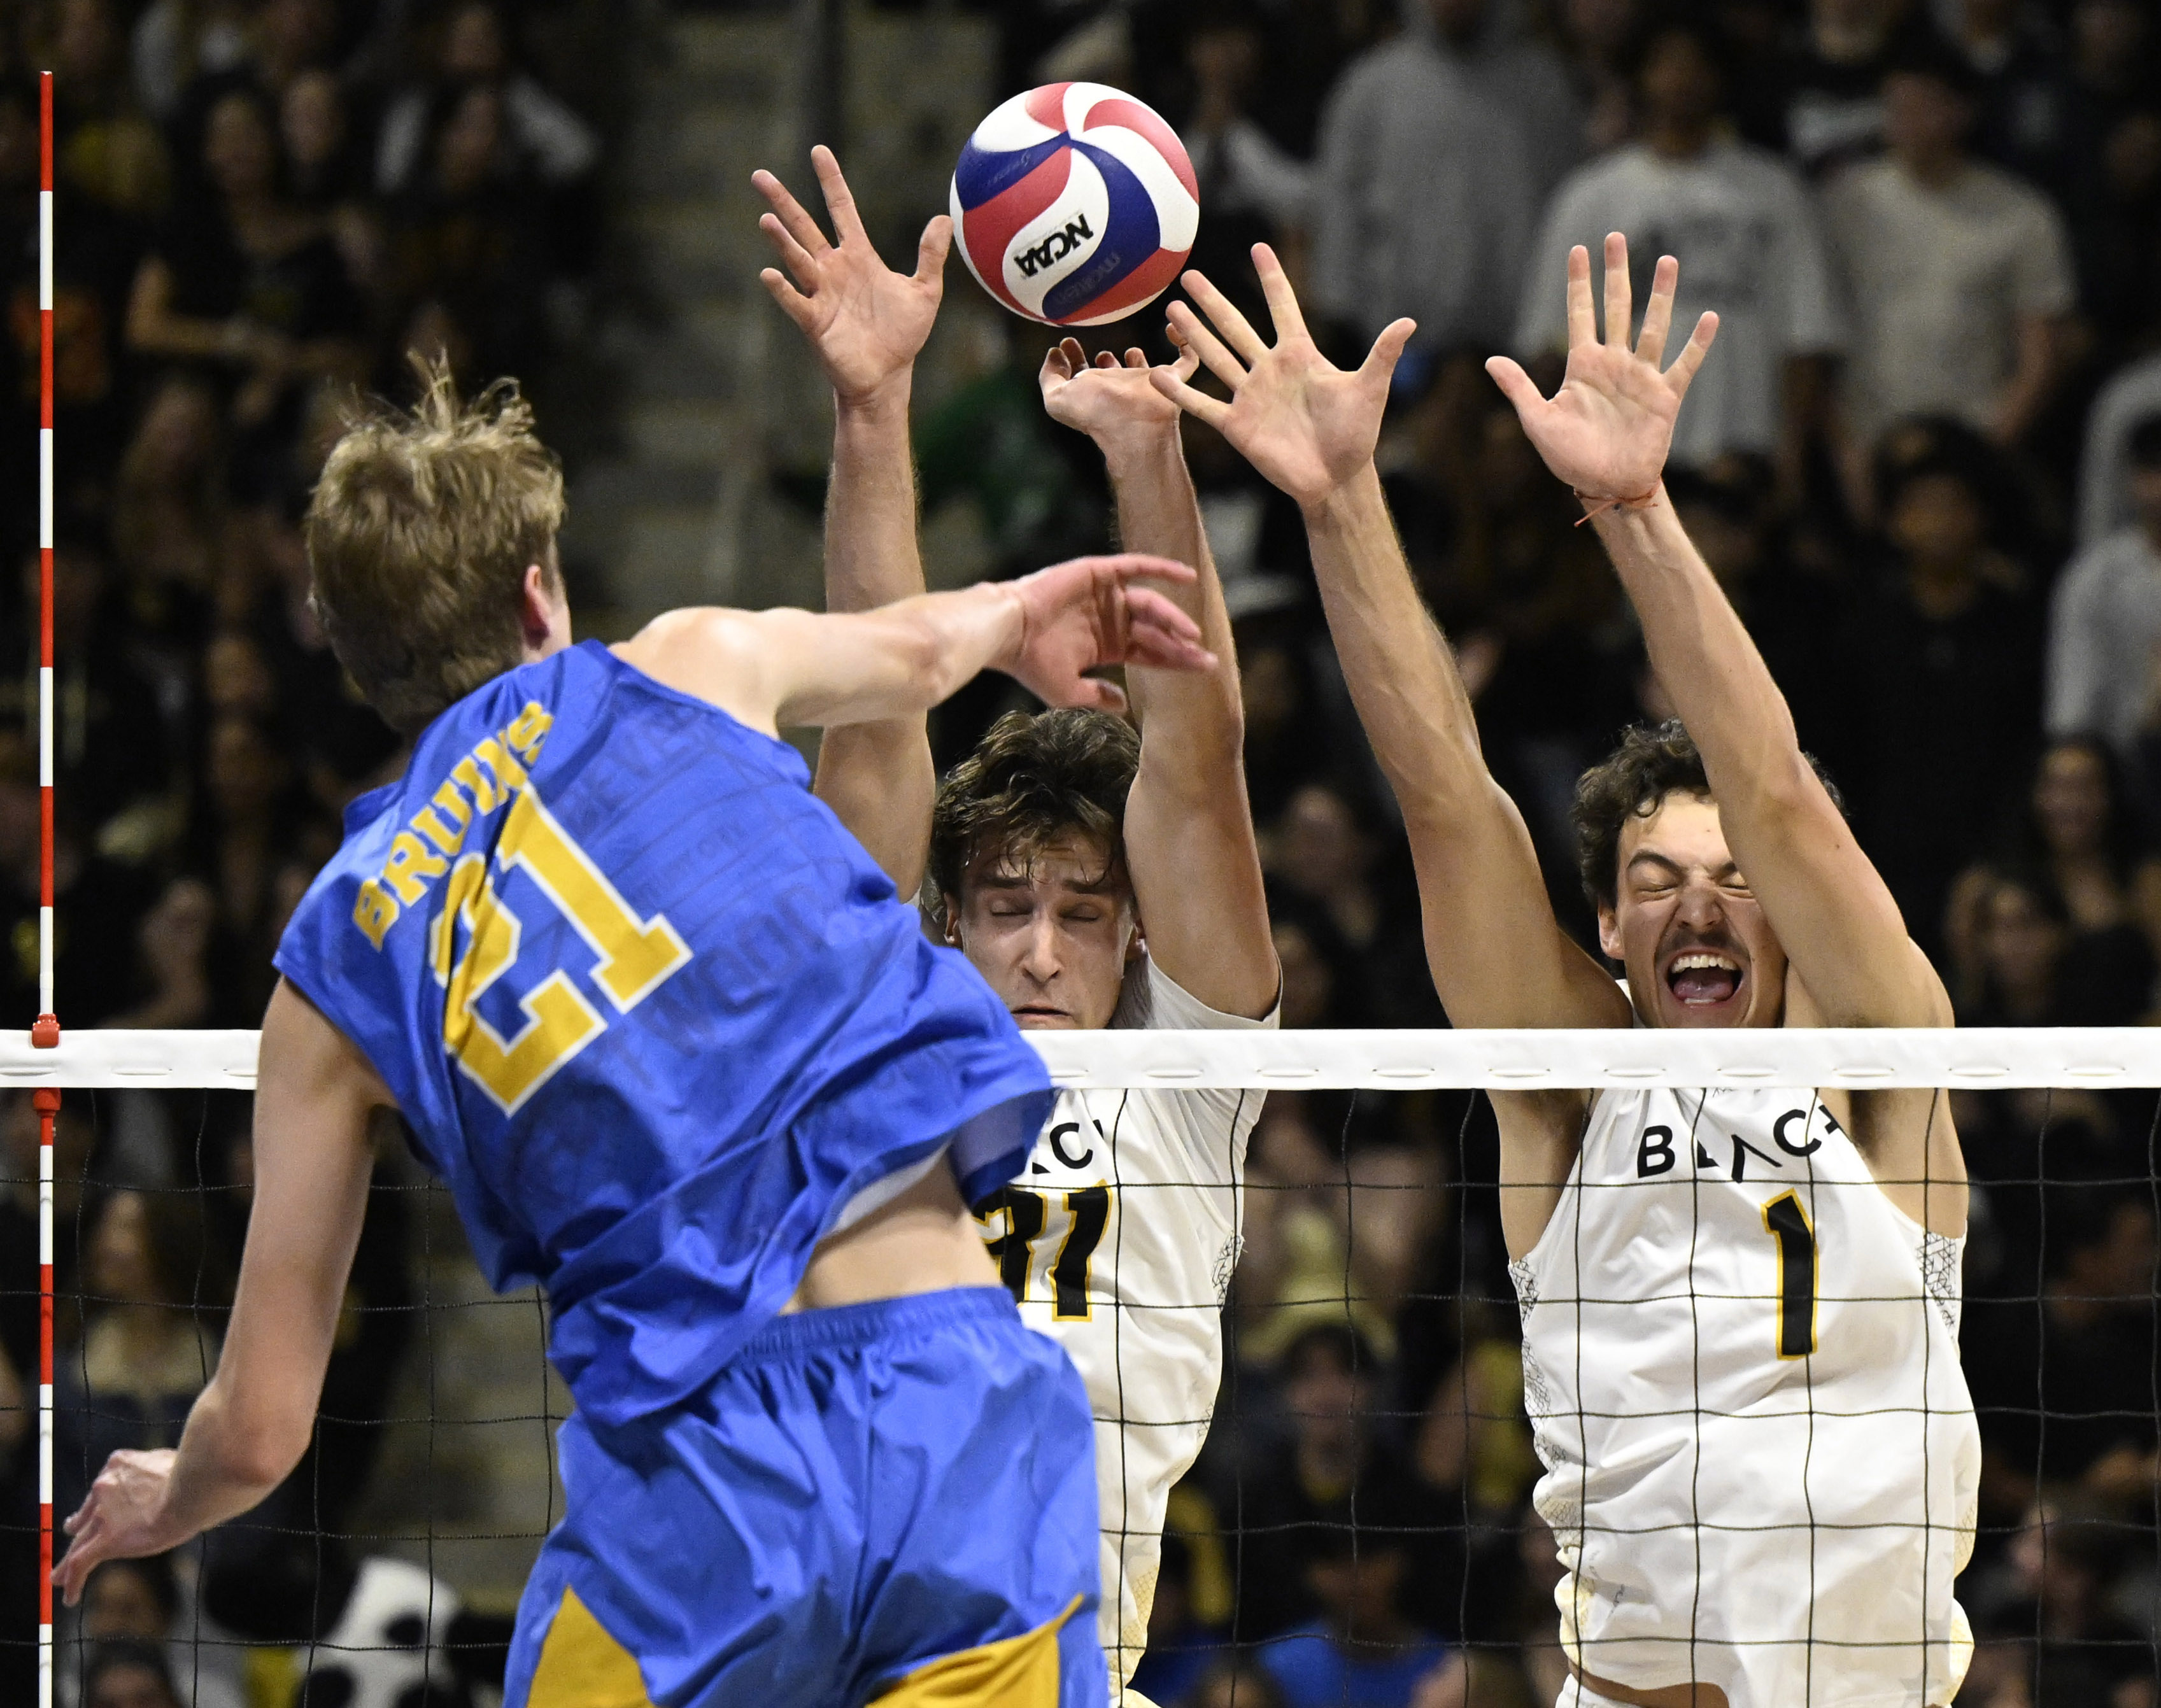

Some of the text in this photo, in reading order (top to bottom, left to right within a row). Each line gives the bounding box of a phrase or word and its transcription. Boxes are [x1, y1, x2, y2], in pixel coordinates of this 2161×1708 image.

[1014, 213, 1095, 278] NCAA
[429, 780, 693, 1118] 21
[1761, 1187, 1819, 1361] 1
